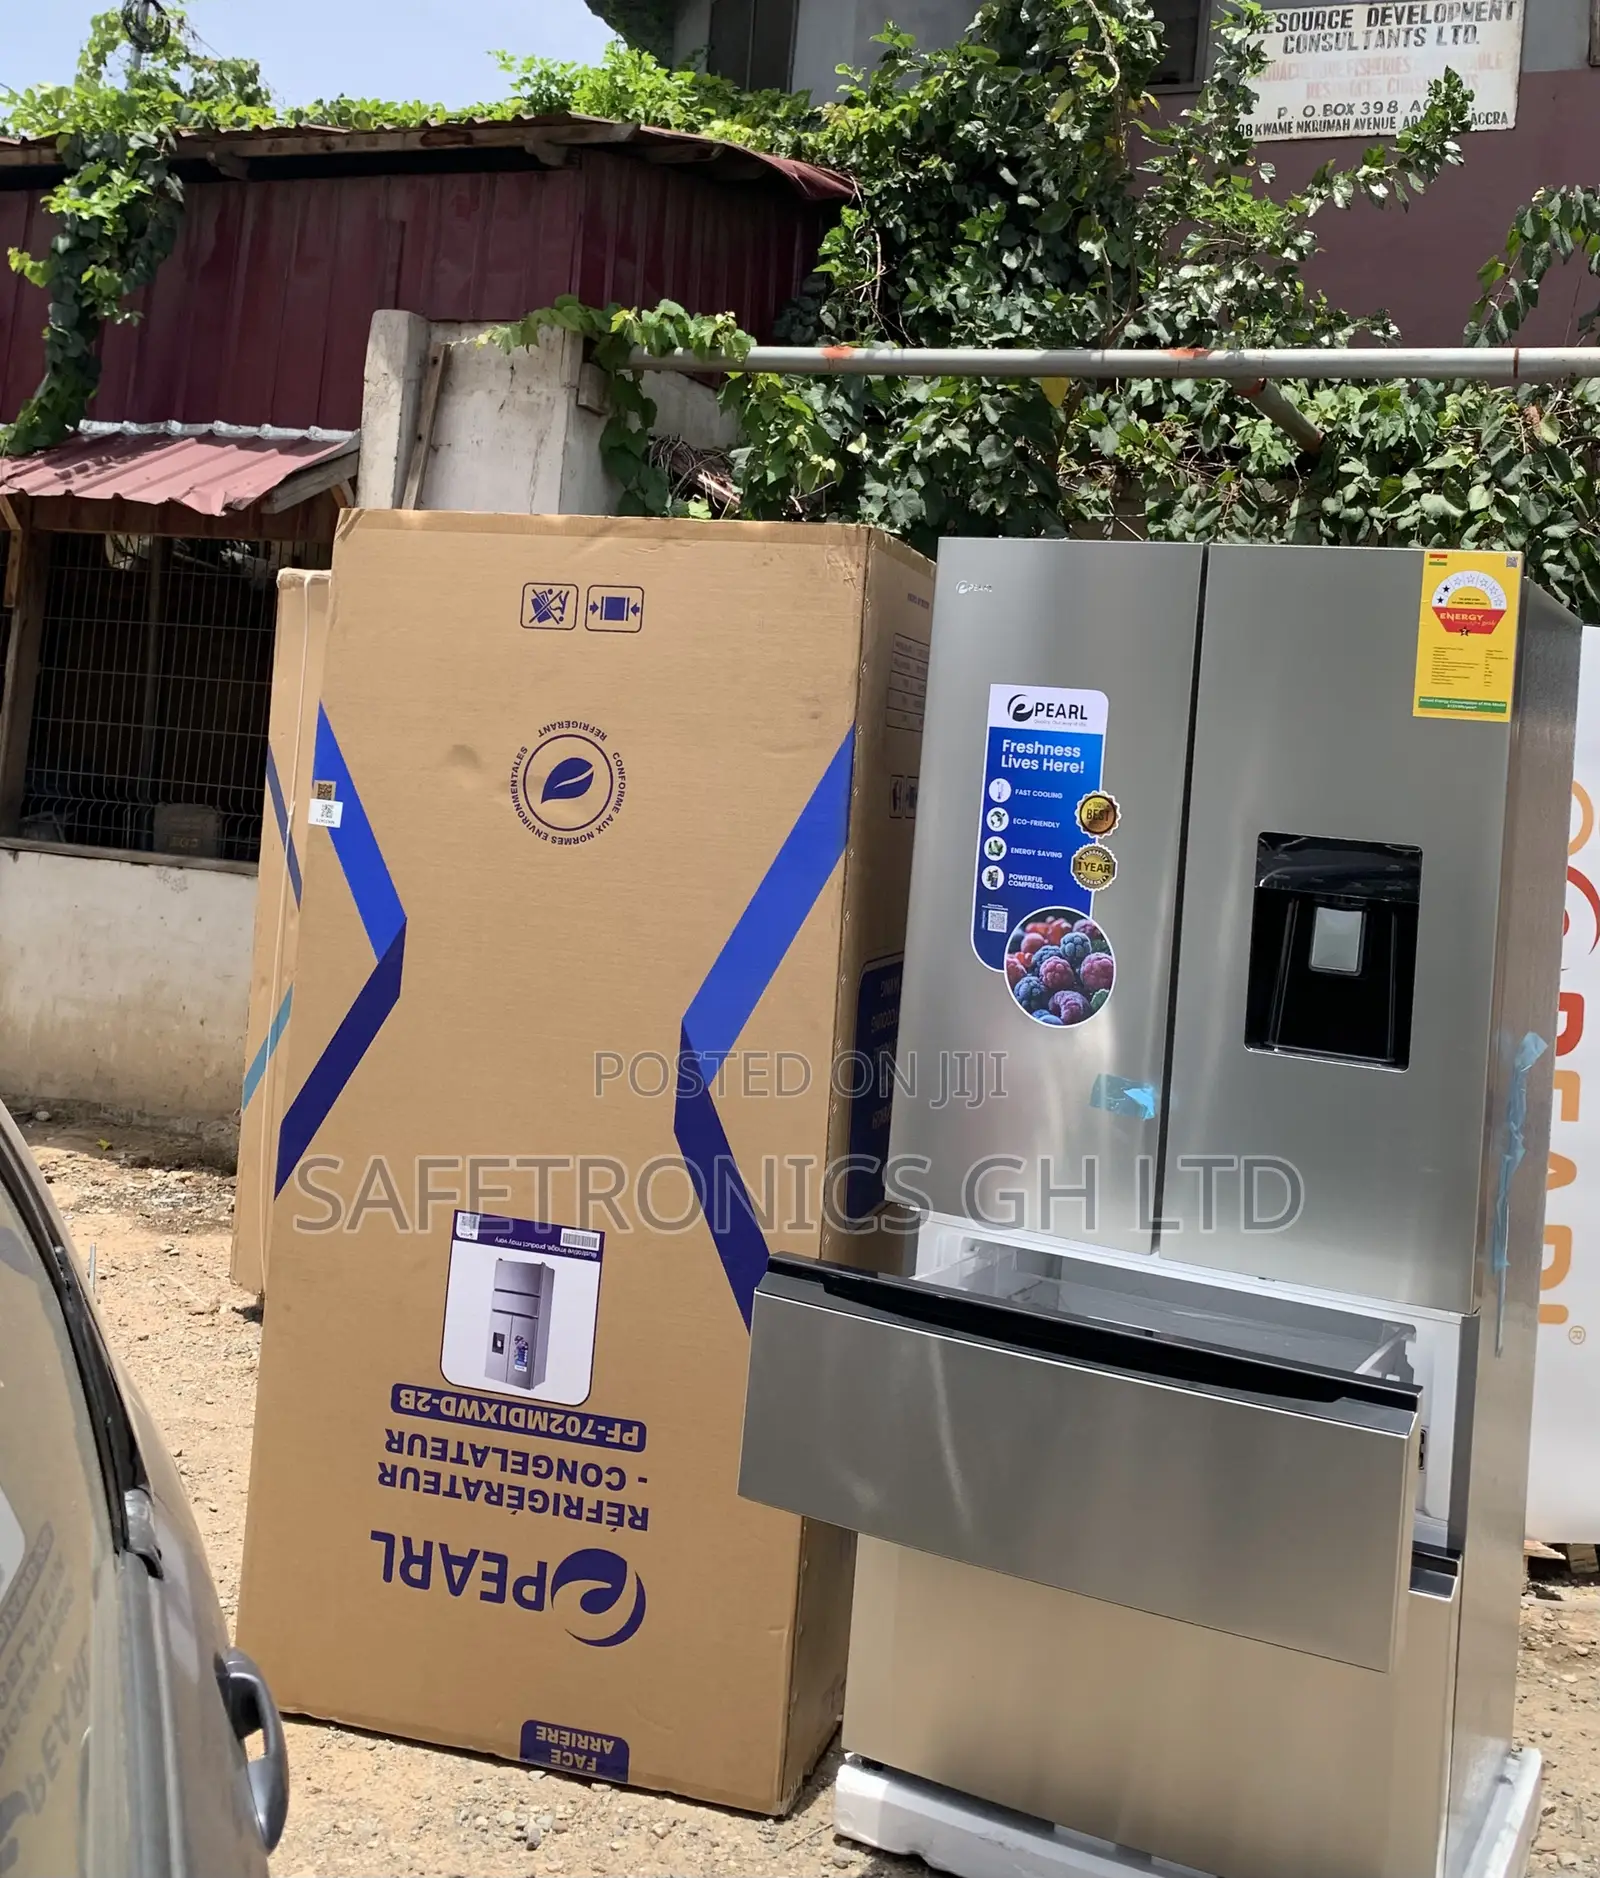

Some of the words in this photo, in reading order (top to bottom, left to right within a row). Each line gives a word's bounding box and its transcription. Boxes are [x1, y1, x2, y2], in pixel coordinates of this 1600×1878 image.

[1254, 9, 1353, 34] ESOURCE
[1367, 1, 1517, 27] DEVELOPMENT
[1283, 26, 1427, 54] CONSULTANTS
[1436, 24, 1480, 46] LTD.
[1255, 120, 1293, 136] KWAME
[1296, 118, 1350, 133] NKRUMAH
[1353, 116, 1397, 130] AVENUE
[1471, 111, 1508, 126] ACCRA
[1439, 612, 1485, 622] ENERGY
[1034, 702, 1088, 721] PEARL
[1002, 739, 1081, 758] Freshness
[1001, 754, 1039, 770] Lives
[1043, 758, 1085, 774] Here!
[612, 752, 626, 814] CONFORME
[510, 746, 549, 841] ENVIRONMENTALES
[1015, 789, 1031, 797] FAST
[1032, 790, 1063, 799] COOLING
[595, 814, 614, 834] AUX
[1013, 818, 1060, 829] ECO-FRIENDLY
[1086, 809, 1110, 822] BEST
[551, 831, 595, 846] NORMES
[1010, 847, 1036, 856] ENERGY
[1037, 849, 1063, 859] SAVING
[1084, 862, 1111, 874] YEAR
[1008, 873, 1043, 883] POWERFUL
[1008, 880, 1054, 891] COMPRESSOR
[495, 1236, 508, 1244] vary
[508, 1238, 522, 1246] may
[522, 1241, 546, 1250] product
[399, 1387, 641, 1446] PF-702MDIXWD-2B
[385, 1429, 627, 1491] CONGELATEUR
[377, 1461, 649, 1532] RÉFRIGÉRATEUR
[370, 1530, 548, 1612] PEARL
[535, 1725, 615, 1755] ARRIÈRE
[551, 1749, 597, 1772] FACE
